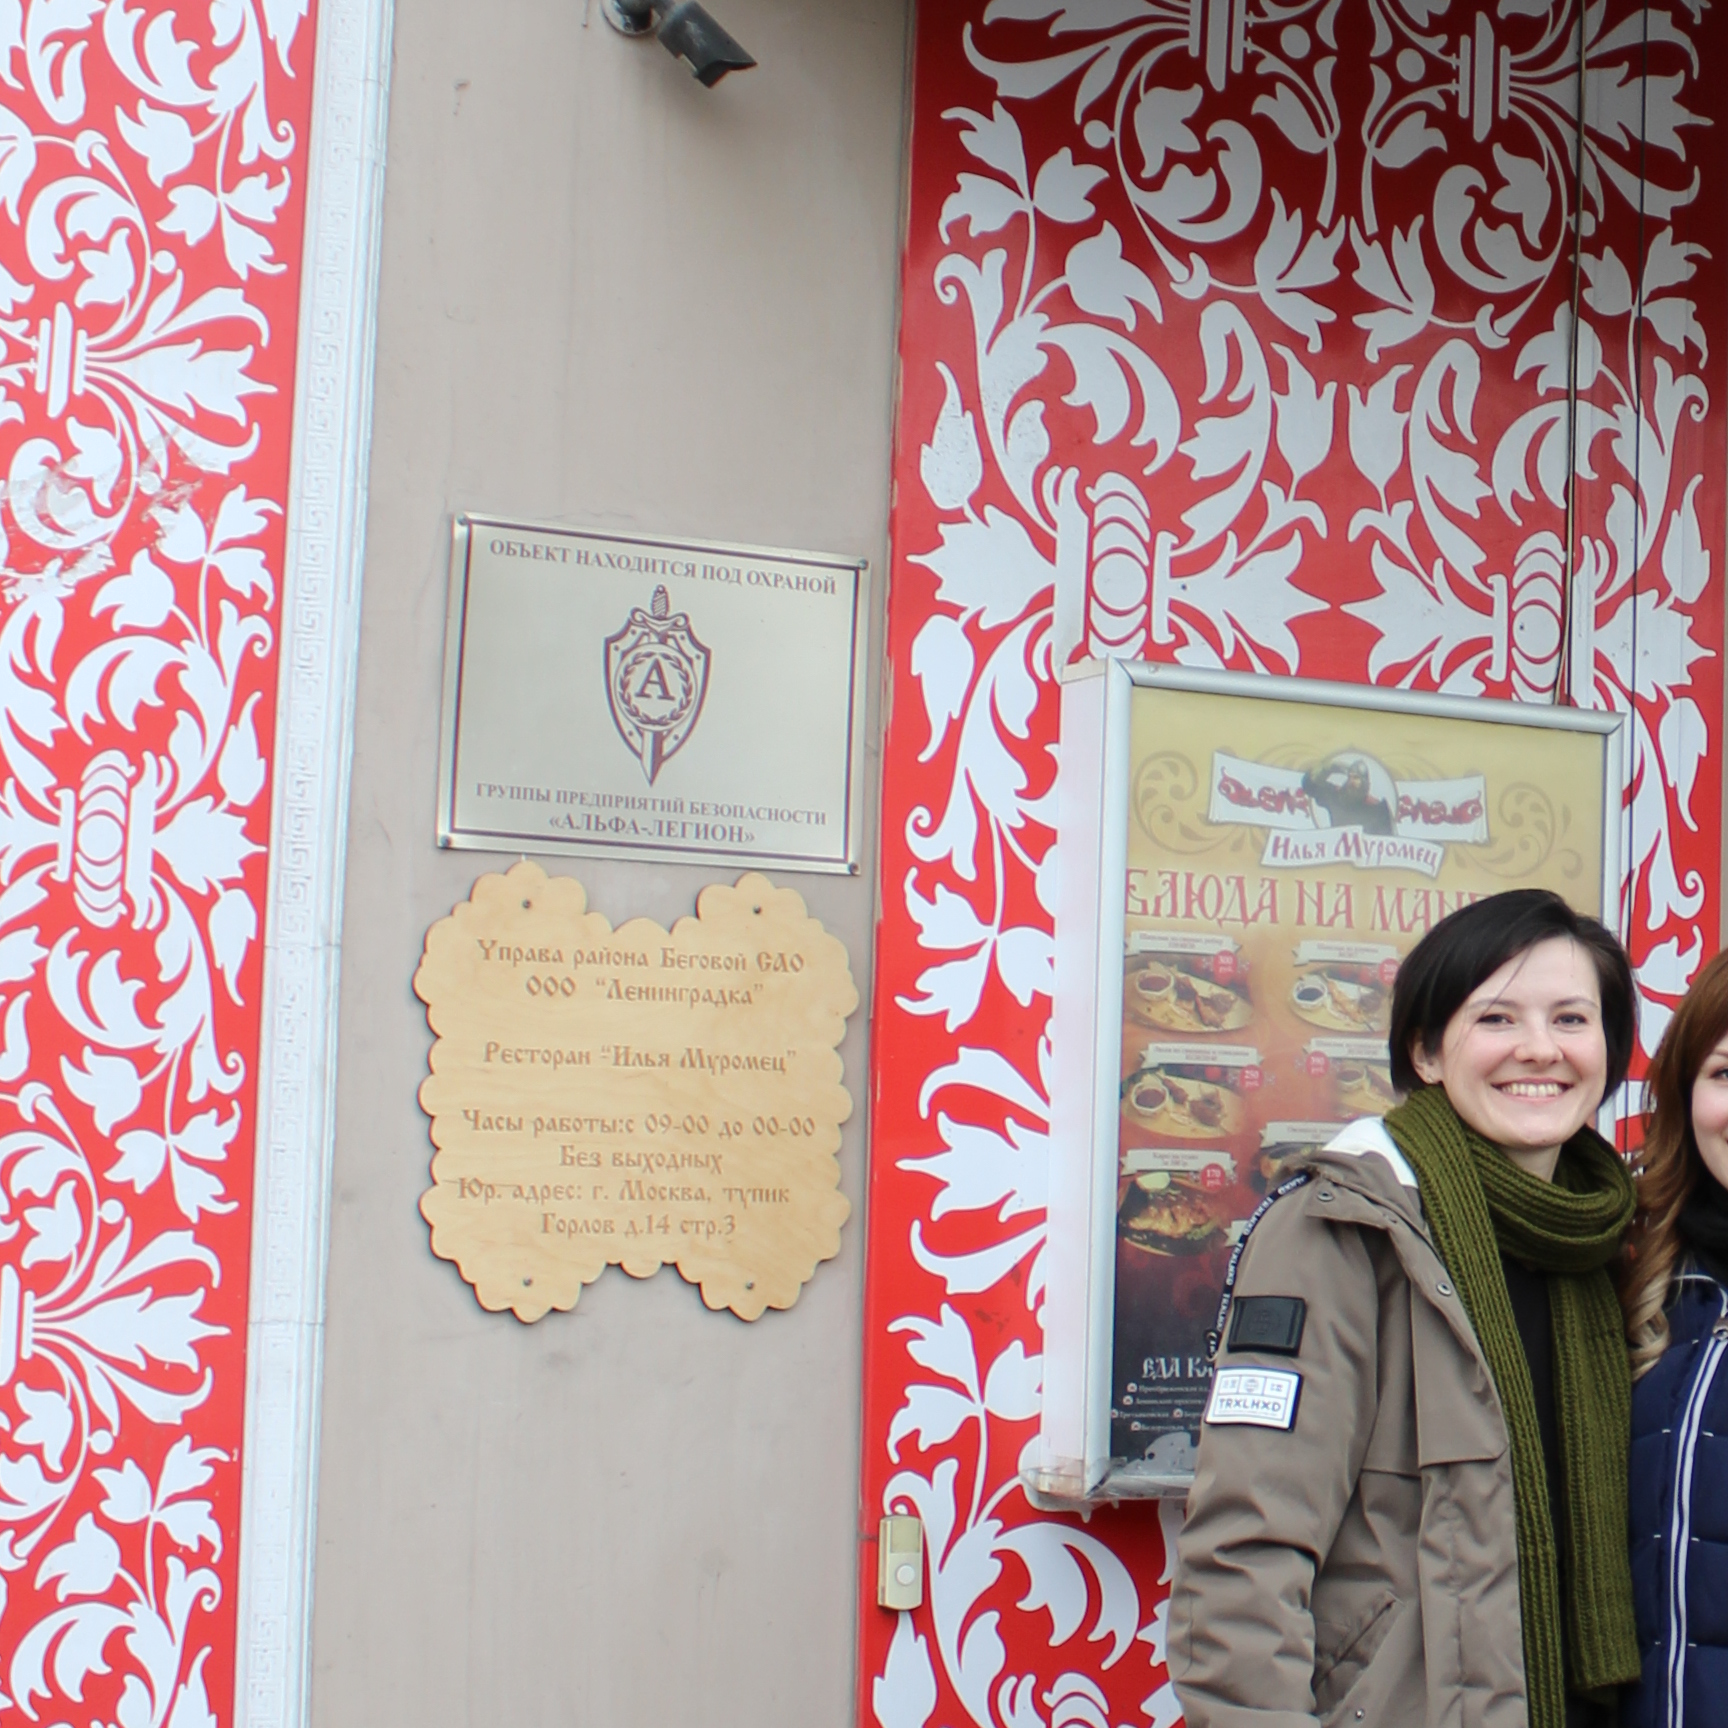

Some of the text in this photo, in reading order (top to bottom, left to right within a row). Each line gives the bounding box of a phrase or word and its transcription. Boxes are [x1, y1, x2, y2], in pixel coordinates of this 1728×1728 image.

[489, 538, 837, 595] ОБЪЕКТ НАХОДИТСЯ ПОД ОХРАНОЙ
[475, 782, 827, 826] ГРУППЫ ПРЕДПРИЯТИЙ БЕЗОПАСНОСТИ
[549, 812, 756, 844] «АЛЬФА-ЛЕГИОН»
[1125, 867, 1494, 934] БЛЮДА НА МАН
[476, 938, 565, 966] Управа
[573, 946, 649, 970] района
[659, 947, 747, 972] Беговой
[525, 975, 577, 997] ООО
[483, 1041, 592, 1070] Ресторан
[462, 1109, 524, 1134] Часы
[644, 1113, 710, 1135] 09-00
[718, 1120, 744, 1139] до
[752, 1115, 816, 1137] 00-00
[559, 1145, 723, 1174] Без выходных
[457, 1177, 503, 1205] Юр.
[512, 1183, 583, 1205] адрес:
[591, 1184, 610, 1202] г.
[722, 1186, 791, 1210] тупик
[540, 1213, 737, 1240] Горлов д.14 стр.3
